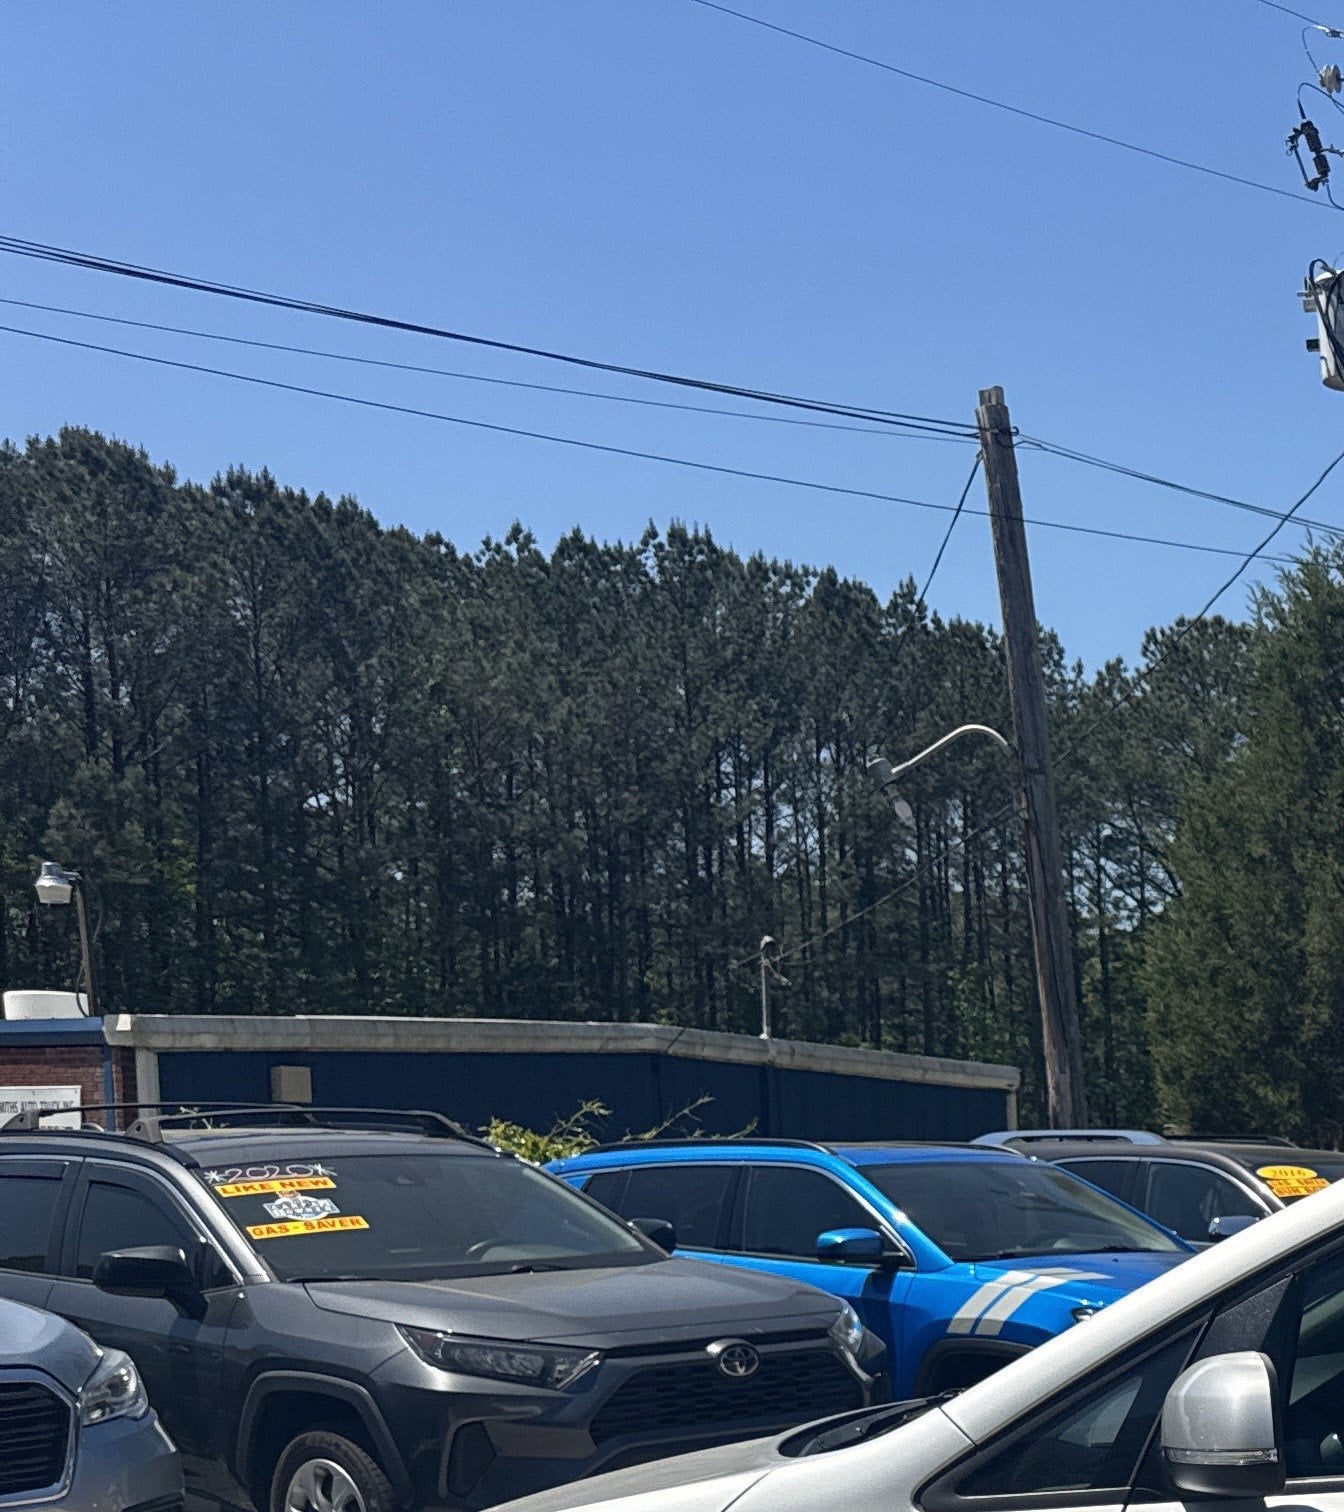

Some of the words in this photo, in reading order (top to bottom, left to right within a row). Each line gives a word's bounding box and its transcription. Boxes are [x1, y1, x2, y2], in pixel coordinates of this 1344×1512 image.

[225, 1164, 313, 1183] 2020
[220, 1183, 274, 1195] LIKE
[280, 1179, 329, 1189] NEW
[252, 1224, 290, 1236] GAS
[303, 1218, 363, 1231] SAVER
